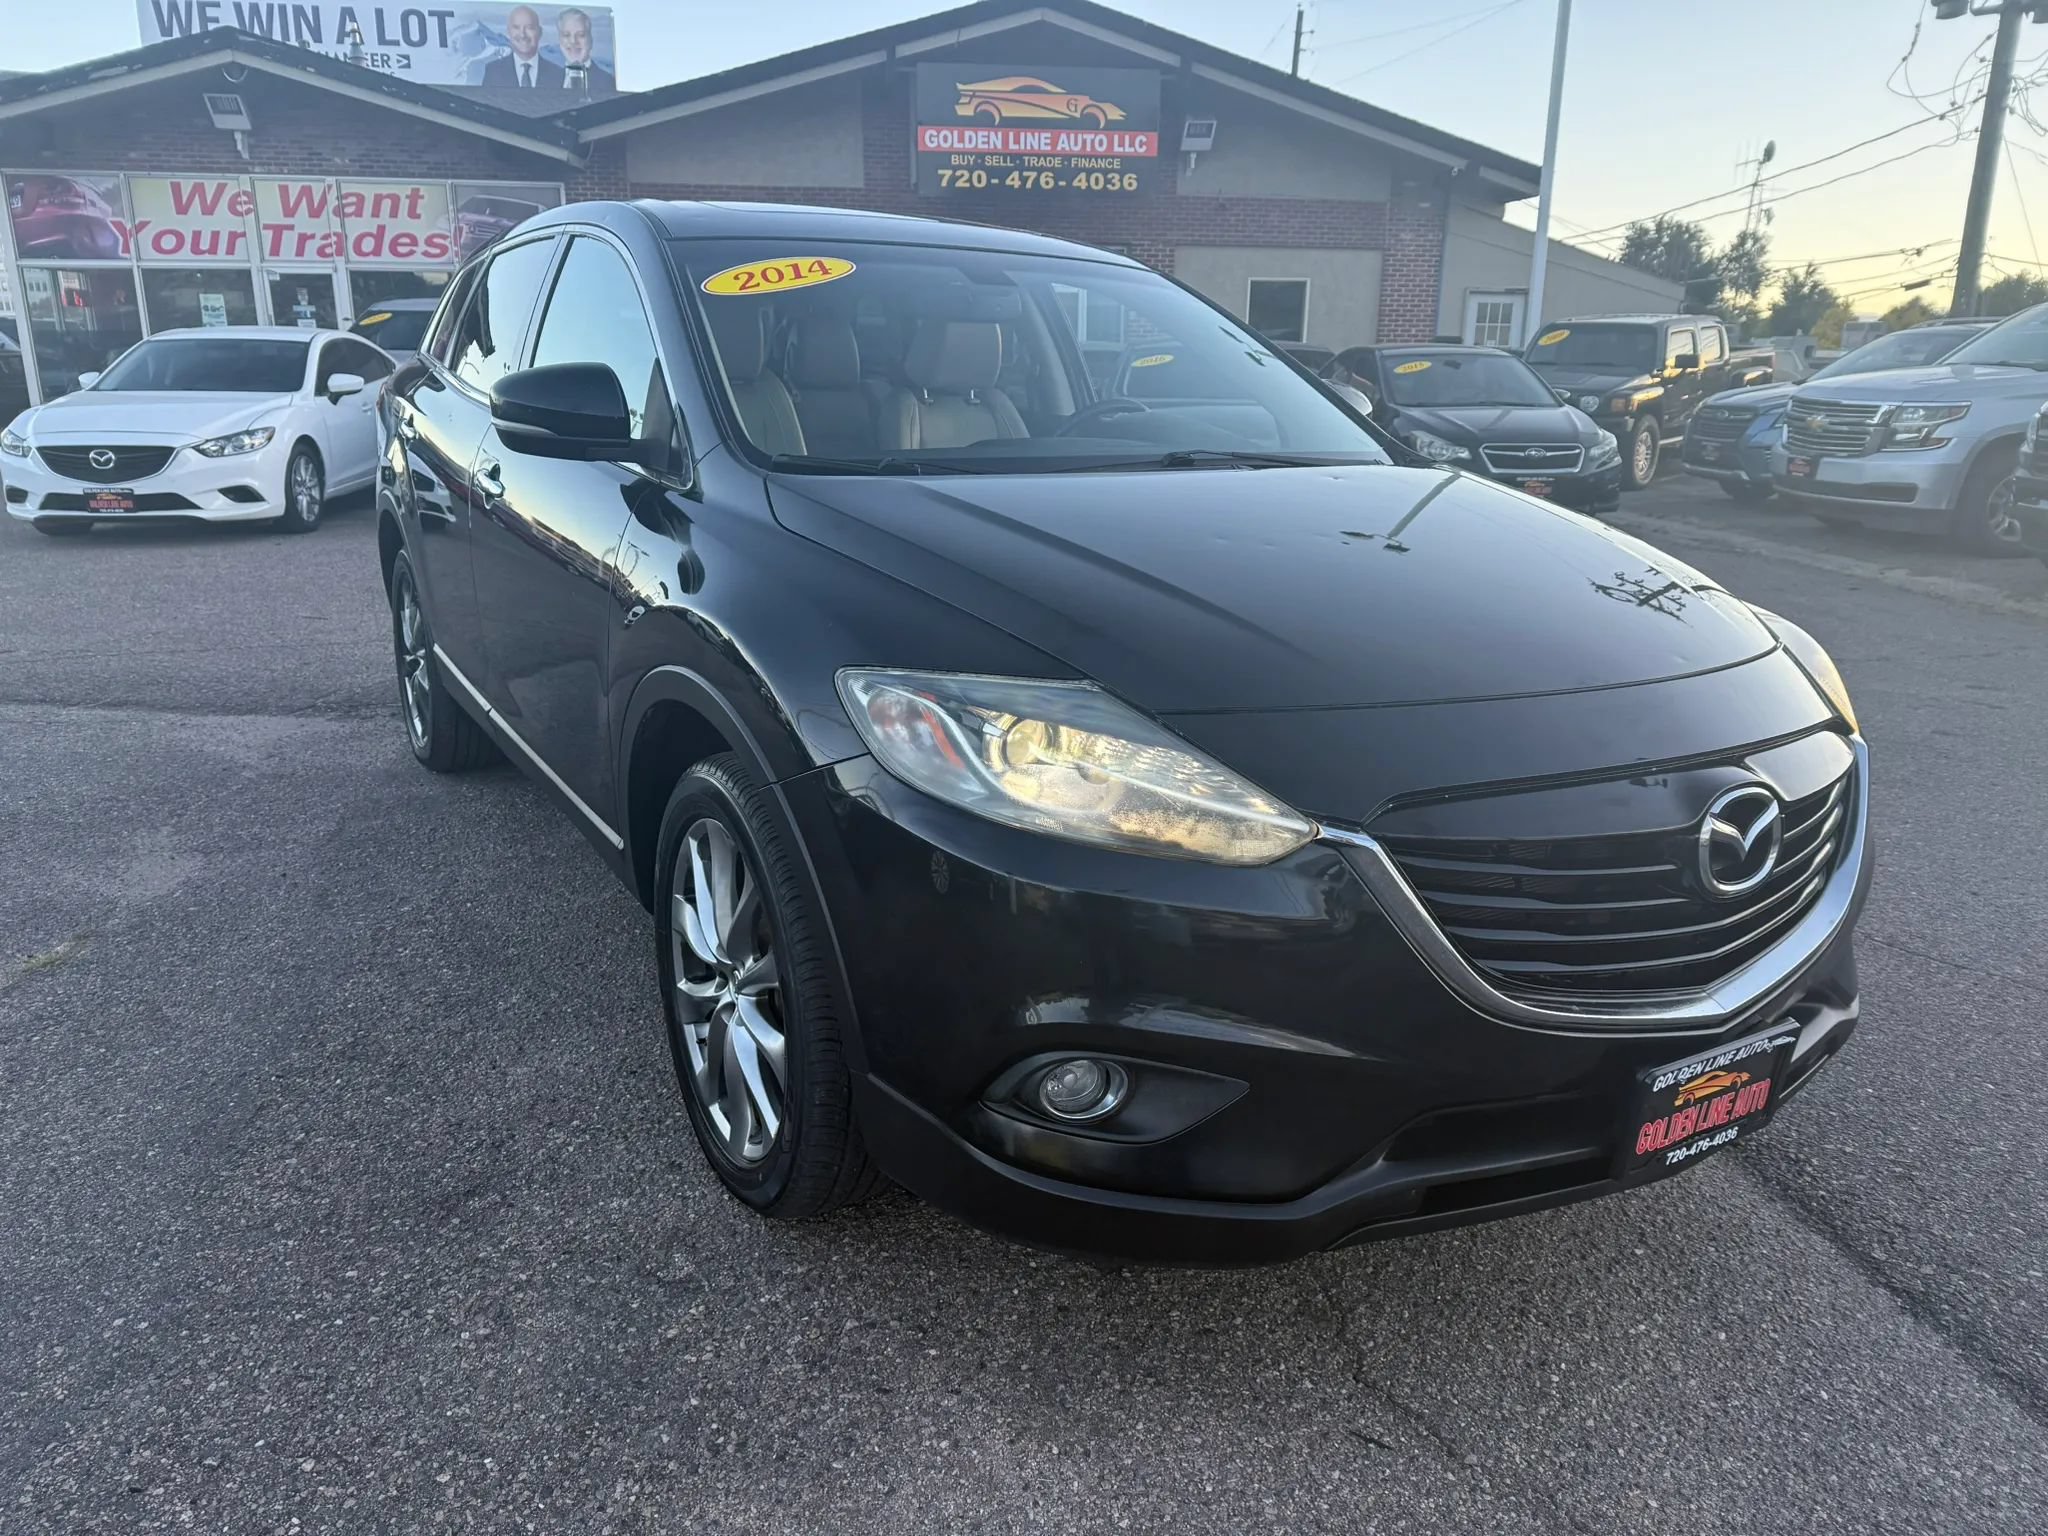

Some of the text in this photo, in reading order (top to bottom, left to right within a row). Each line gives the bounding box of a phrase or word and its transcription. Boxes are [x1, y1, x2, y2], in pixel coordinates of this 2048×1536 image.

[151, 0, 455, 48] WE WIN A LOT
[924, 129, 1147, 153] GOLDEN LINE AUTO LLC
[951, 154, 1121, 169] BUY SELL TRADE FINANCE
[170, 181, 425, 219] We Want
[109, 220, 464, 259] Your Trades!
[733, 259, 833, 291] 2014
[1653, 1038, 1770, 1093] GOLDEN LINE AUTO
[1636, 1078, 1771, 1155] GOLDEN LINE AUTO
[1665, 1126, 1738, 1165] 720-476-4036
